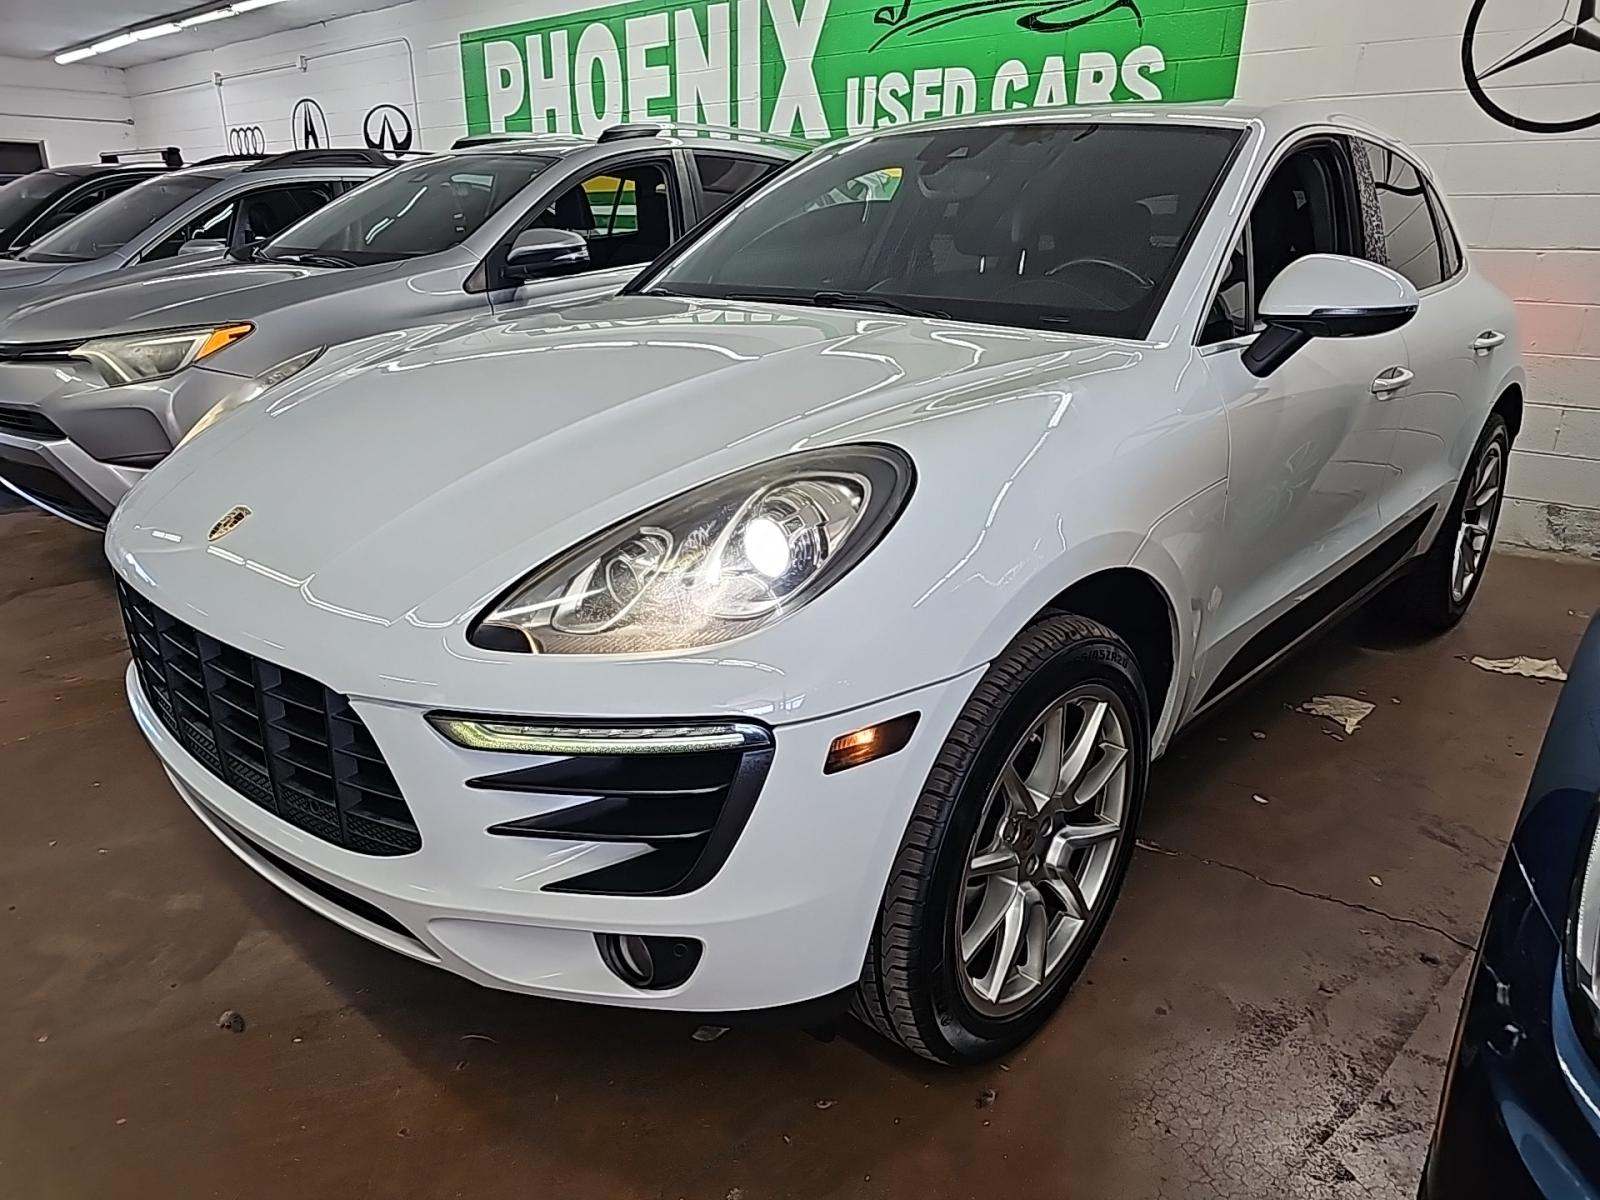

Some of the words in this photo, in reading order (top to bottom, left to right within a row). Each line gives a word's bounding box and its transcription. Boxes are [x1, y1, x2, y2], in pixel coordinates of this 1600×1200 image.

[483, 0, 832, 142] PHOENIX
[846, 66, 976, 136] USED
[991, 44, 1166, 111] CARS
